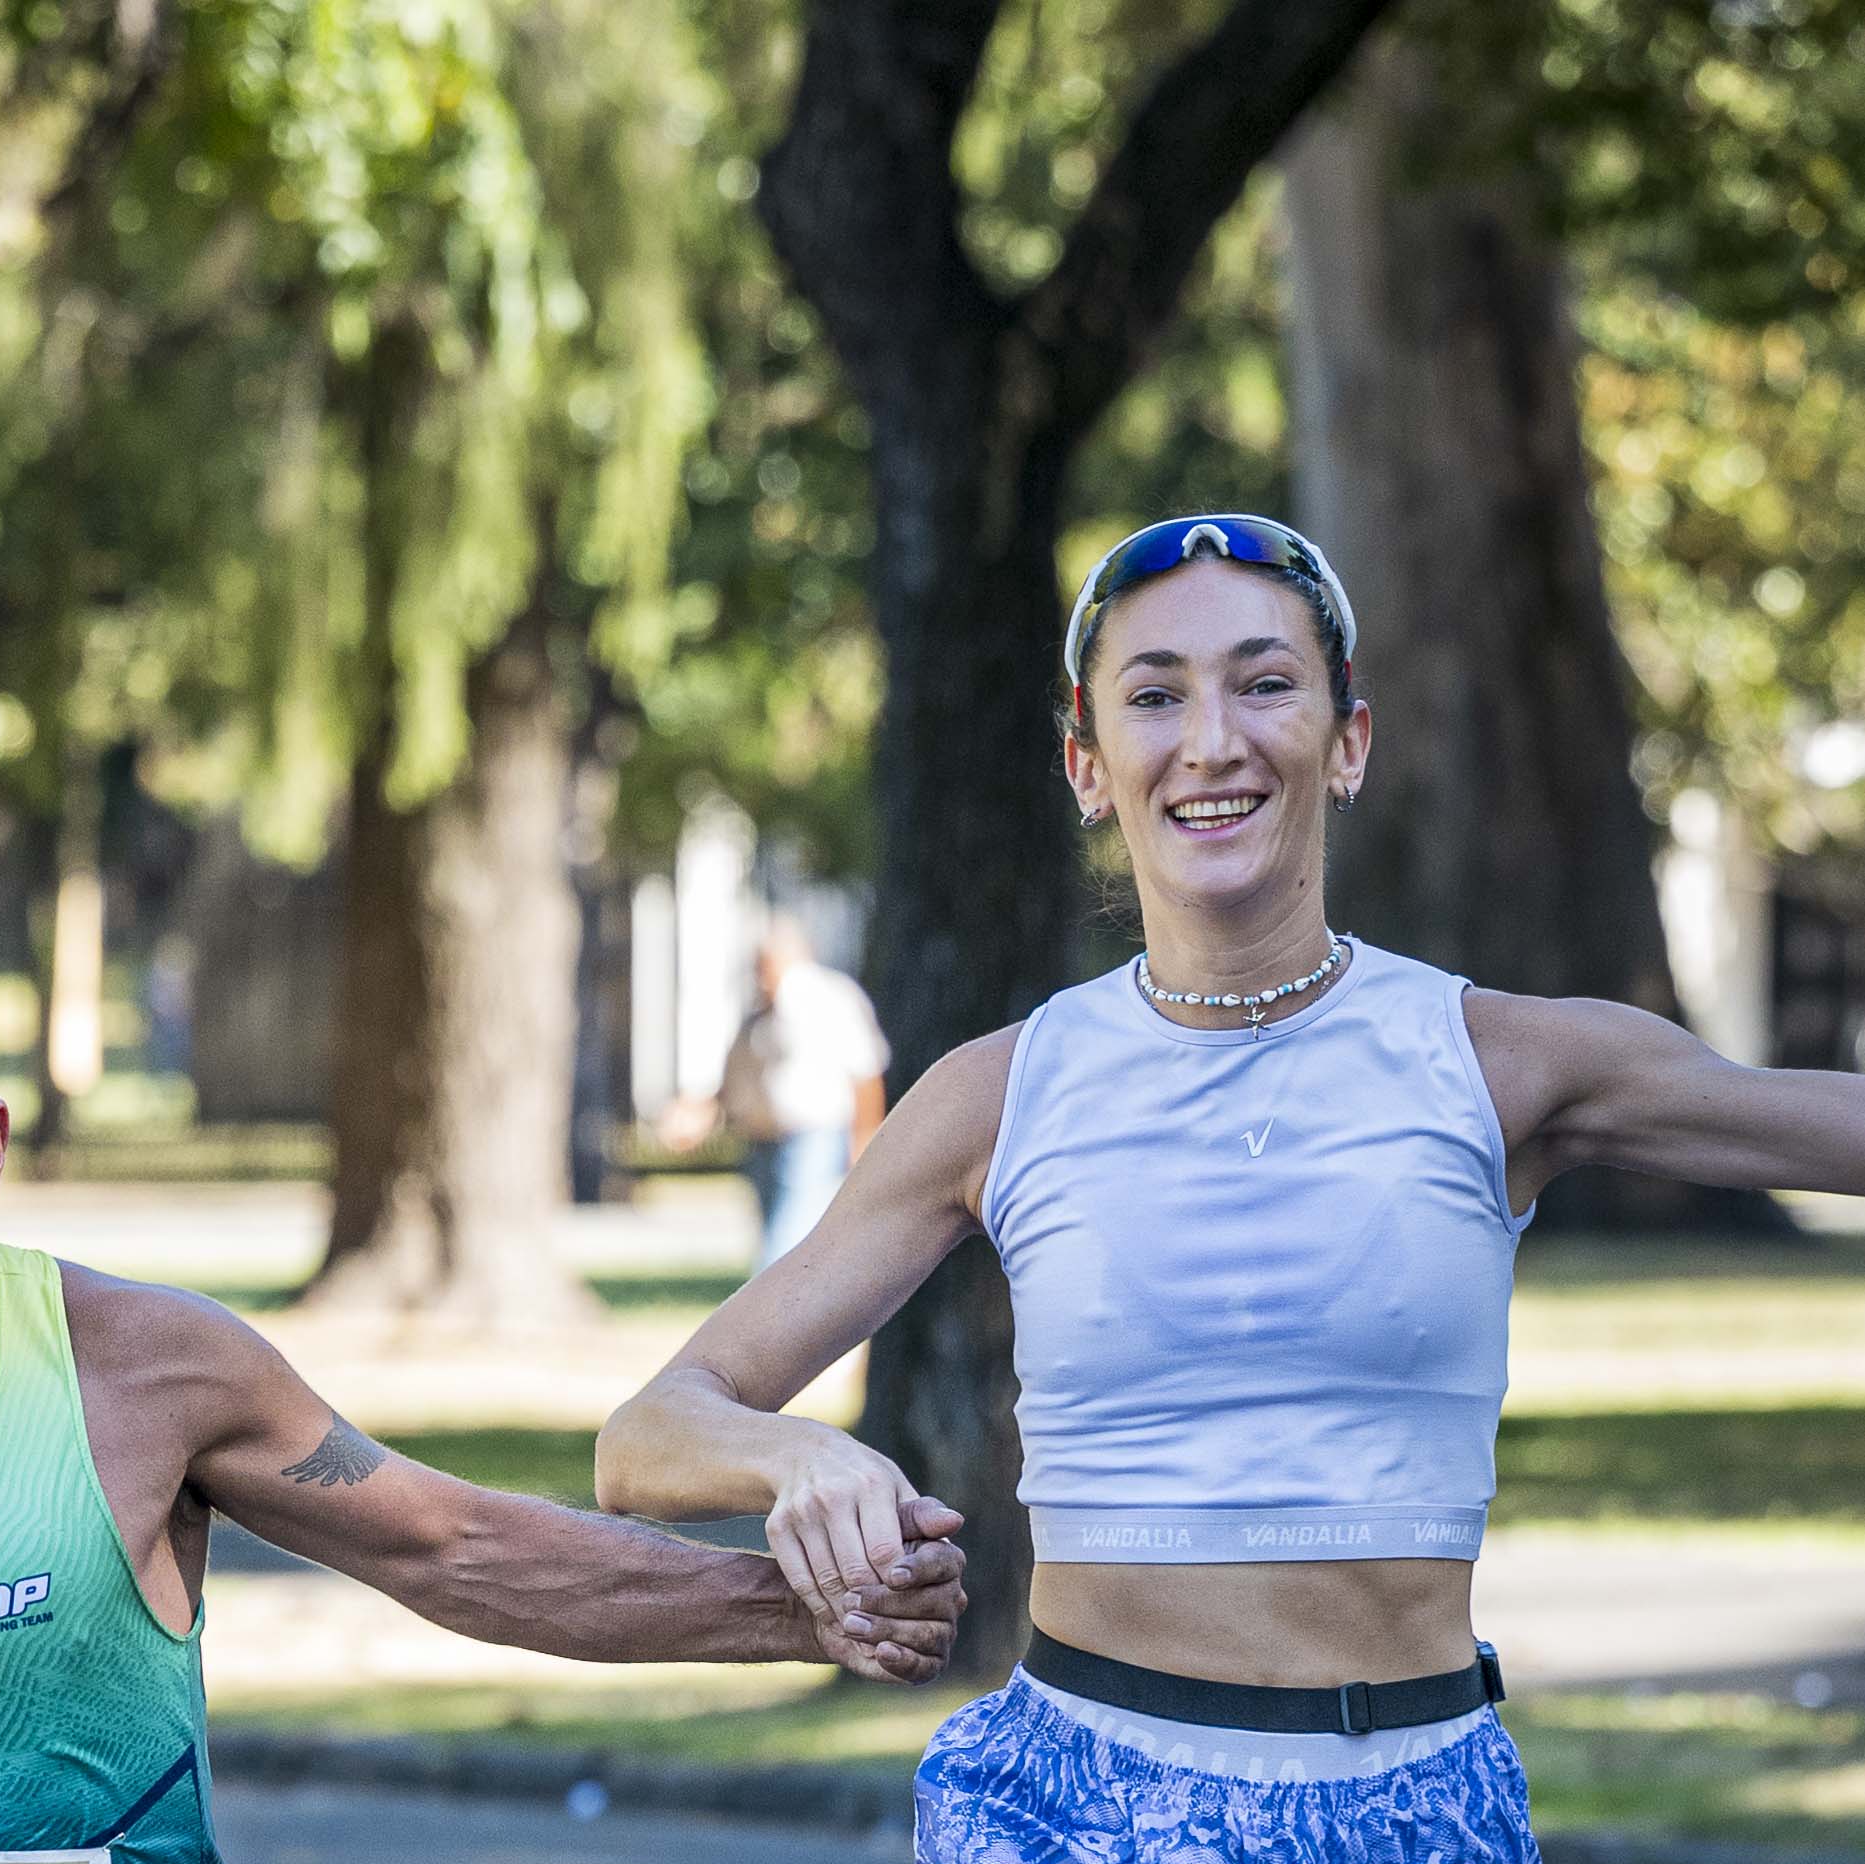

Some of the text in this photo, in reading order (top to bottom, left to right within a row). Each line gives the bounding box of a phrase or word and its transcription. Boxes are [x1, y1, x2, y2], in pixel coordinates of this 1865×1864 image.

[1082, 1524, 1193, 1548] VANDALIA
[1242, 1522, 1372, 1547] VANDALIA
[20, 1611, 54, 1628] TEAM
